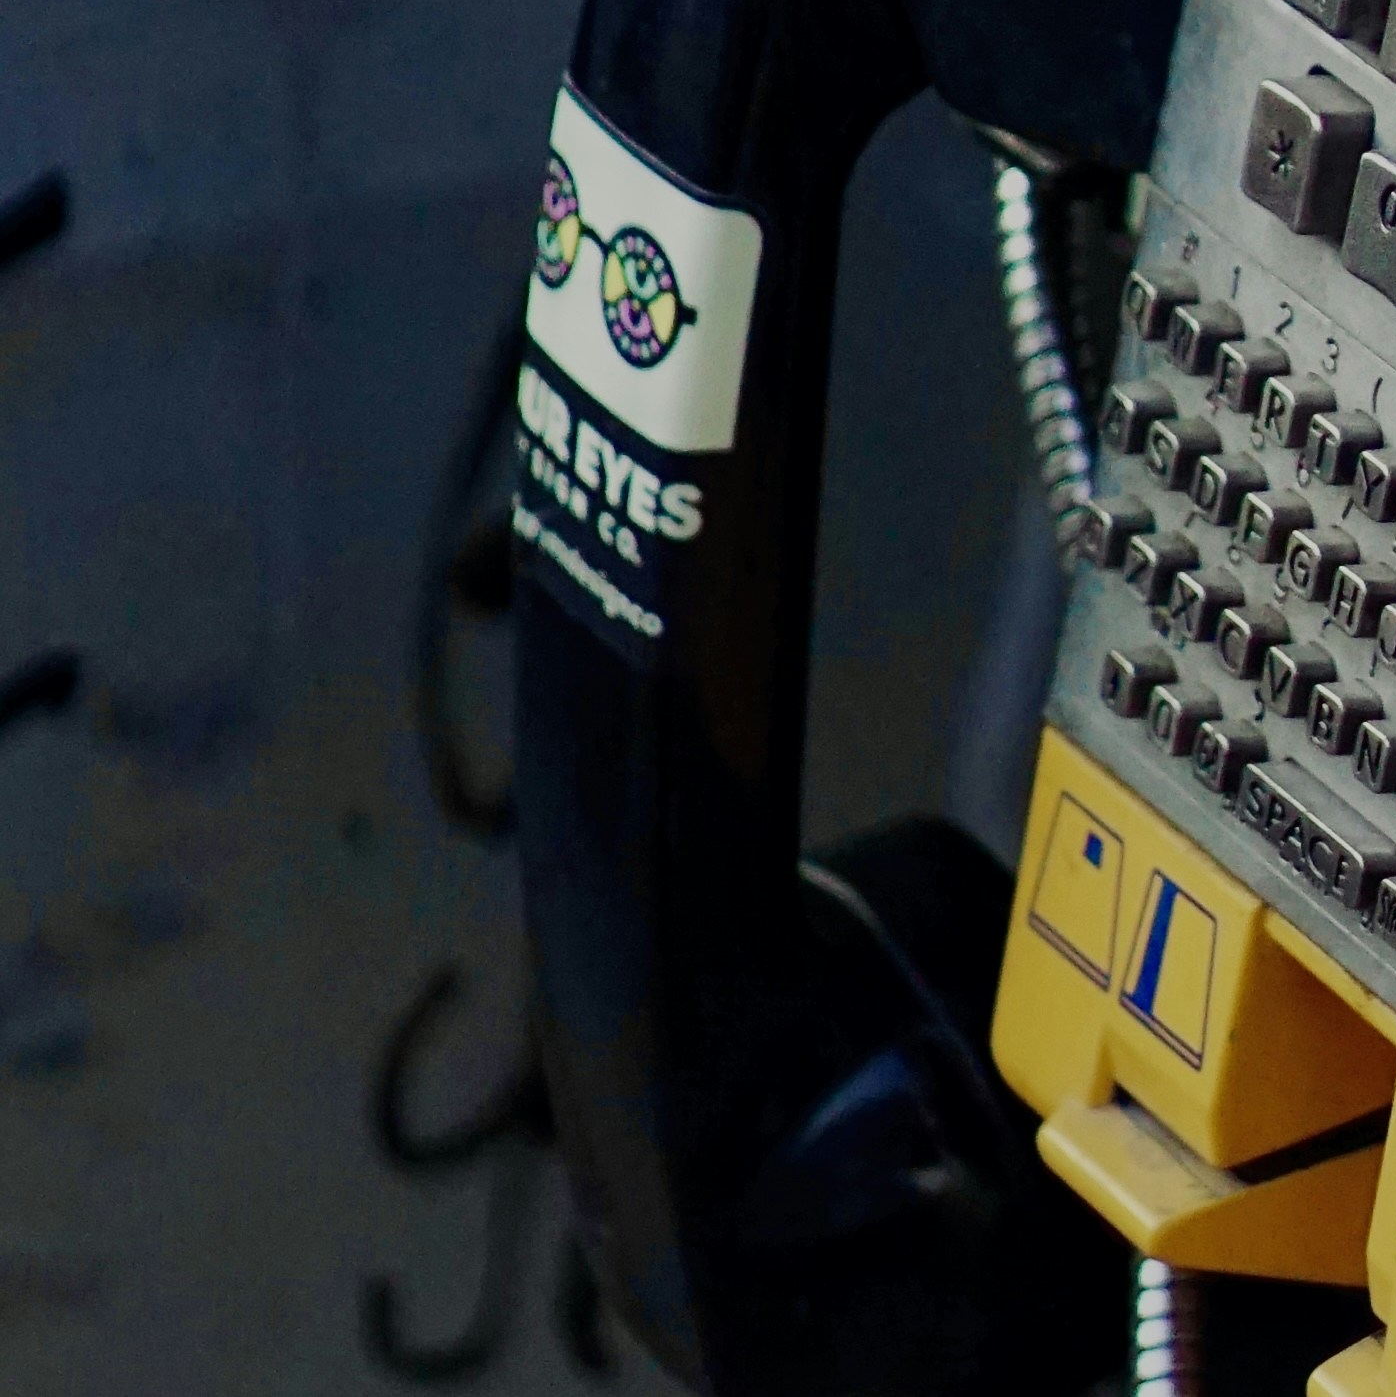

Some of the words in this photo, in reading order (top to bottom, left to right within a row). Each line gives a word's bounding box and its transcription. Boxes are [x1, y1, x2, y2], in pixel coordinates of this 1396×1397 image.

[574, 419, 704, 544] EYES
[1355, 731, 1383, 785] N
[1246, 779, 1352, 899] SPACE
